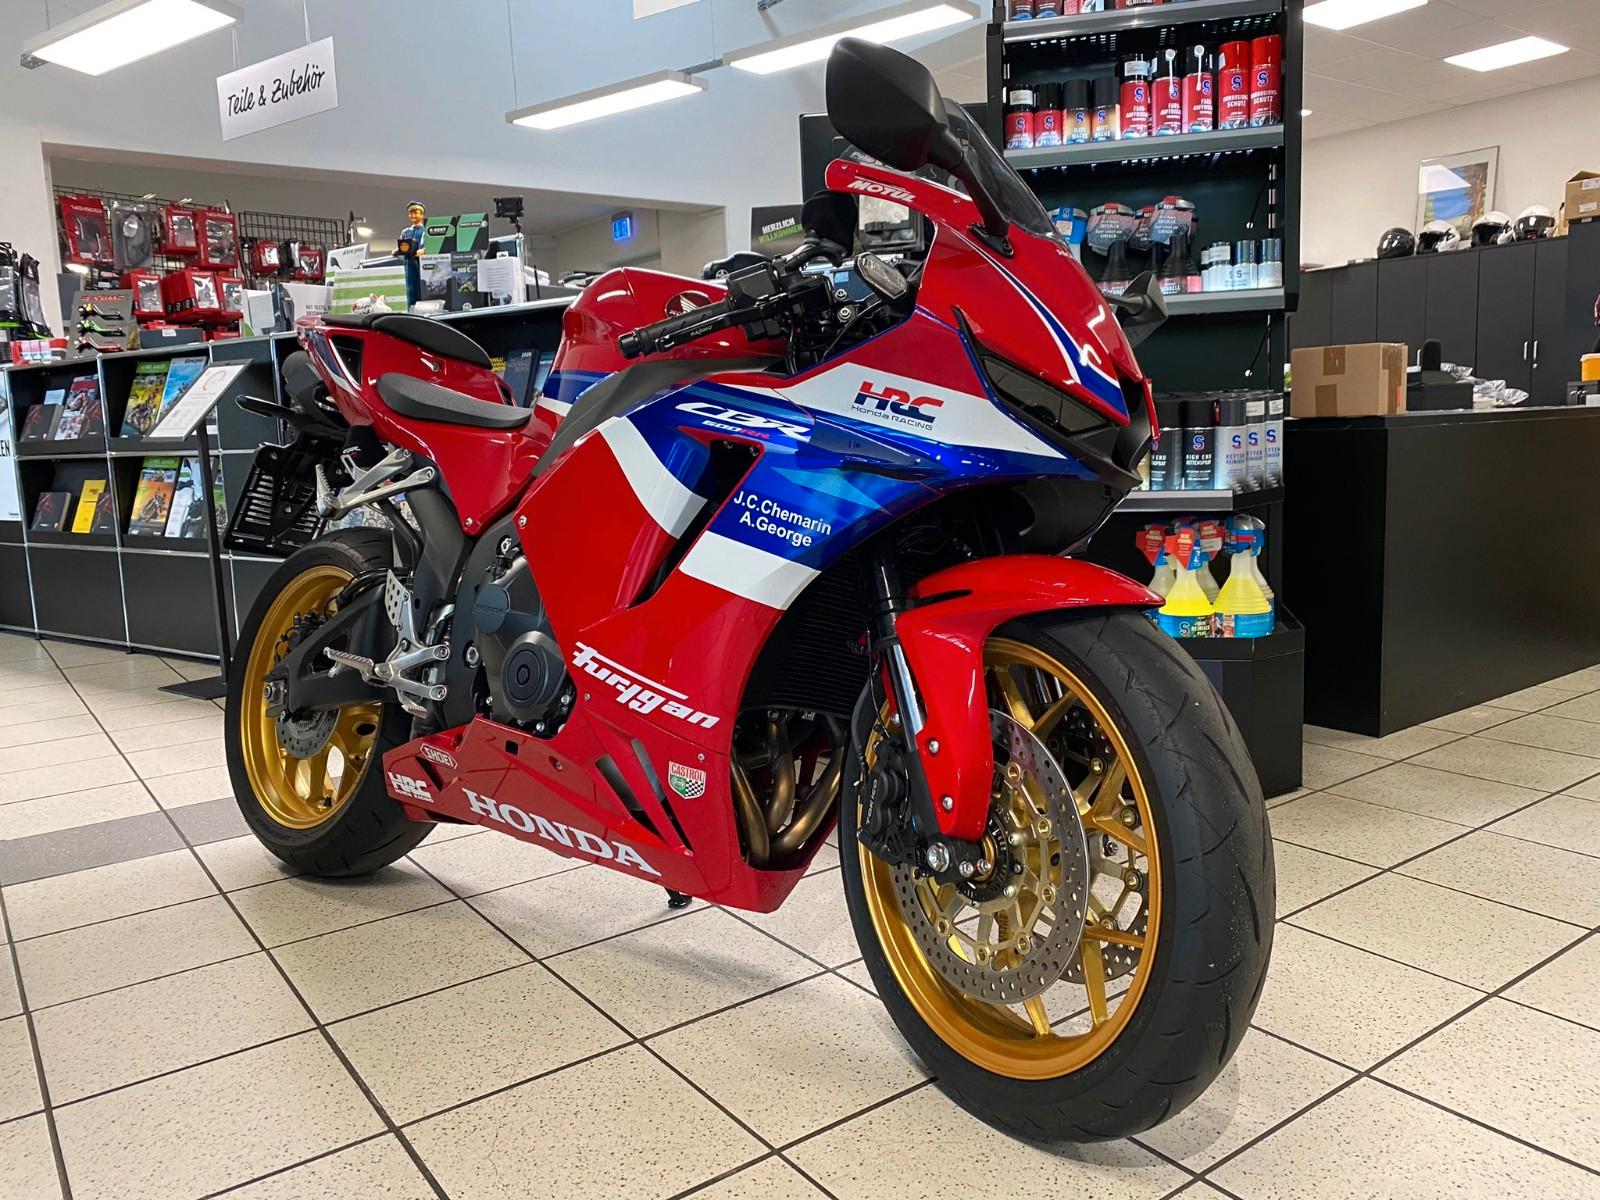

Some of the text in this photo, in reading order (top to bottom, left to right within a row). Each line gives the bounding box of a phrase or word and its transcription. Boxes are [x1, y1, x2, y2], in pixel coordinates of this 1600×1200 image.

[227, 63, 326, 117] Teile & Zubehör
[847, 180, 917, 202] MOTUL
[761, 217, 796, 235] HERZLICH
[851, 404, 934, 431] Honda RACING
[854, 381, 945, 424] HRC
[675, 402, 811, 442] CBR
[734, 490, 832, 536] J.C.Chemarin
[739, 510, 812, 548] A.George
[572, 641, 721, 729] furygan
[424, 747, 454, 768] SHOEI
[671, 763, 704, 782] CASTROL
[388, 771, 432, 799] HRC
[461, 788, 662, 877] HONDA
